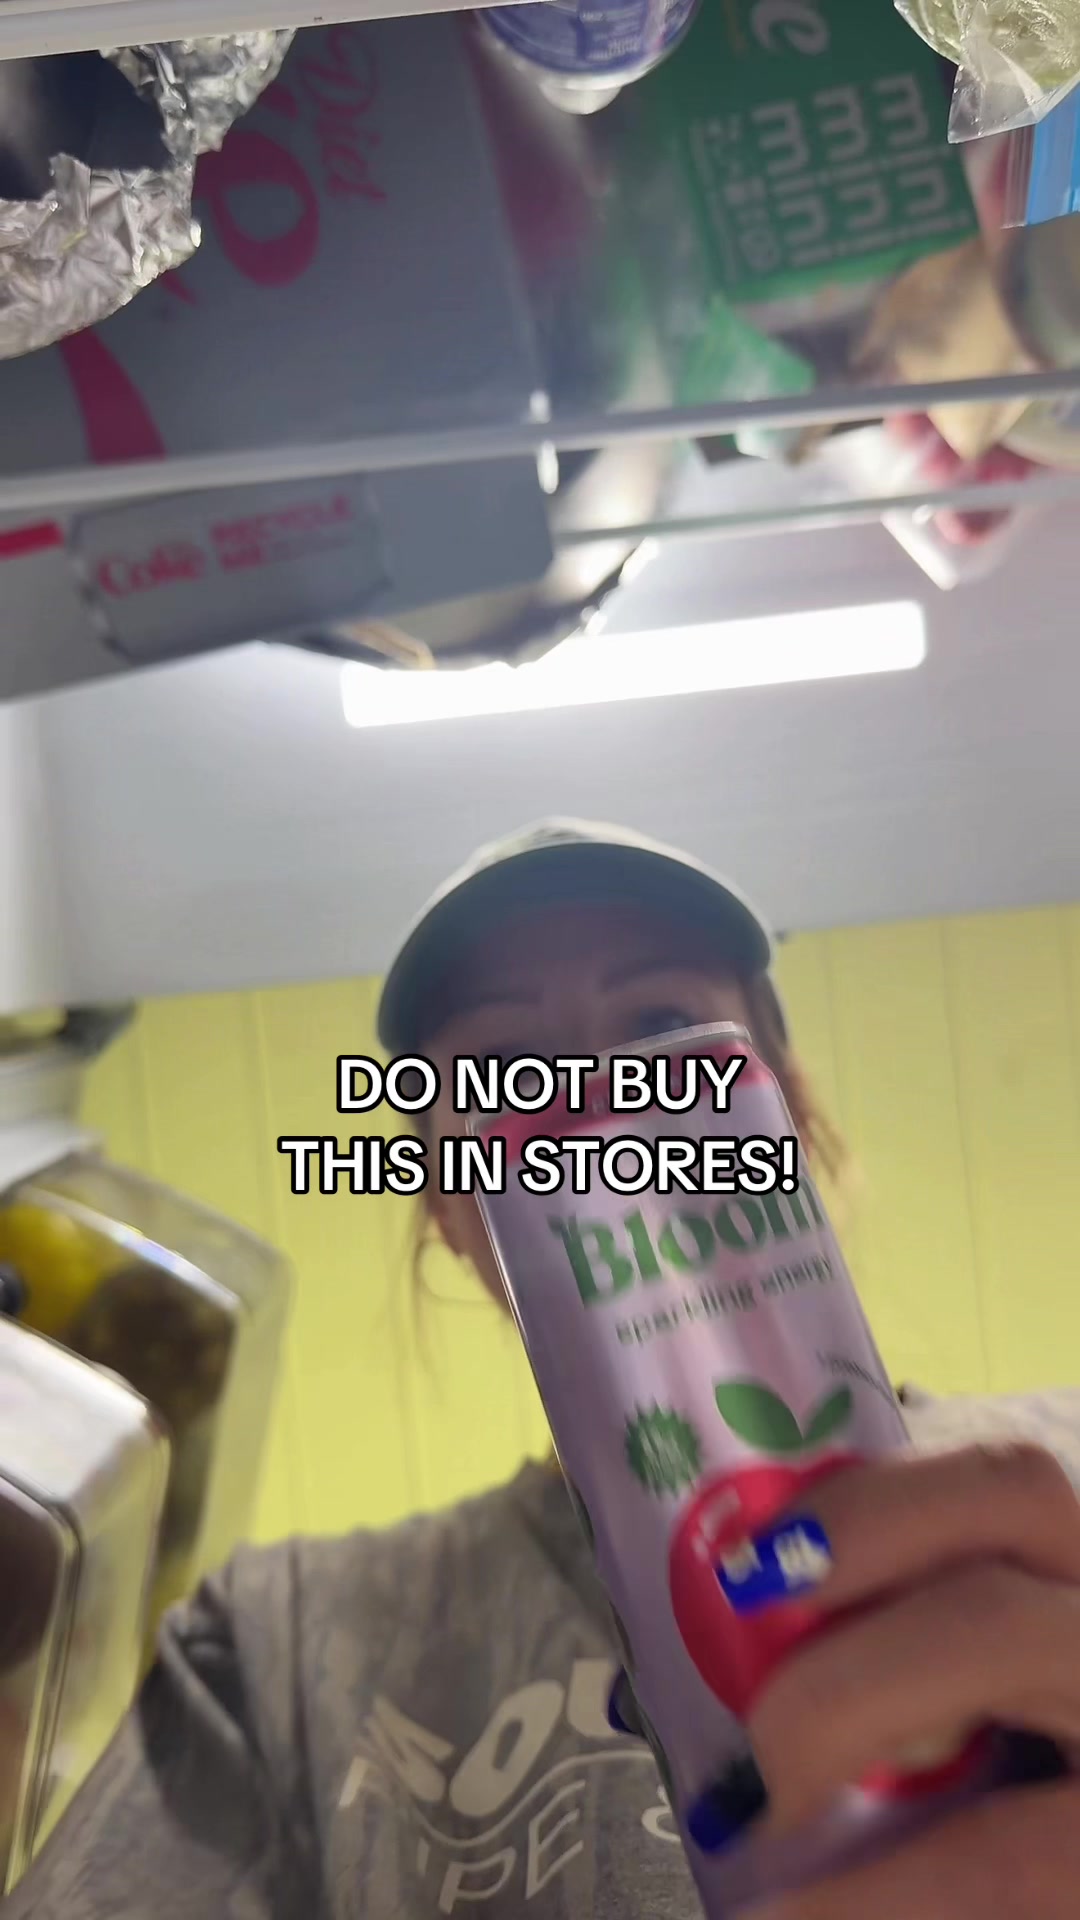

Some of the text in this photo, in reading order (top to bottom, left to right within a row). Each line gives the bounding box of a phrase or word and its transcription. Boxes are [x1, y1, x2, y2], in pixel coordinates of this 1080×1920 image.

[297, 25, 389, 207] Diet
[753, 101, 848, 268] mini
[813, 84, 909, 248] mini
[872, 74, 971, 231] mini
[547, 1175, 826, 1309] Bloom
